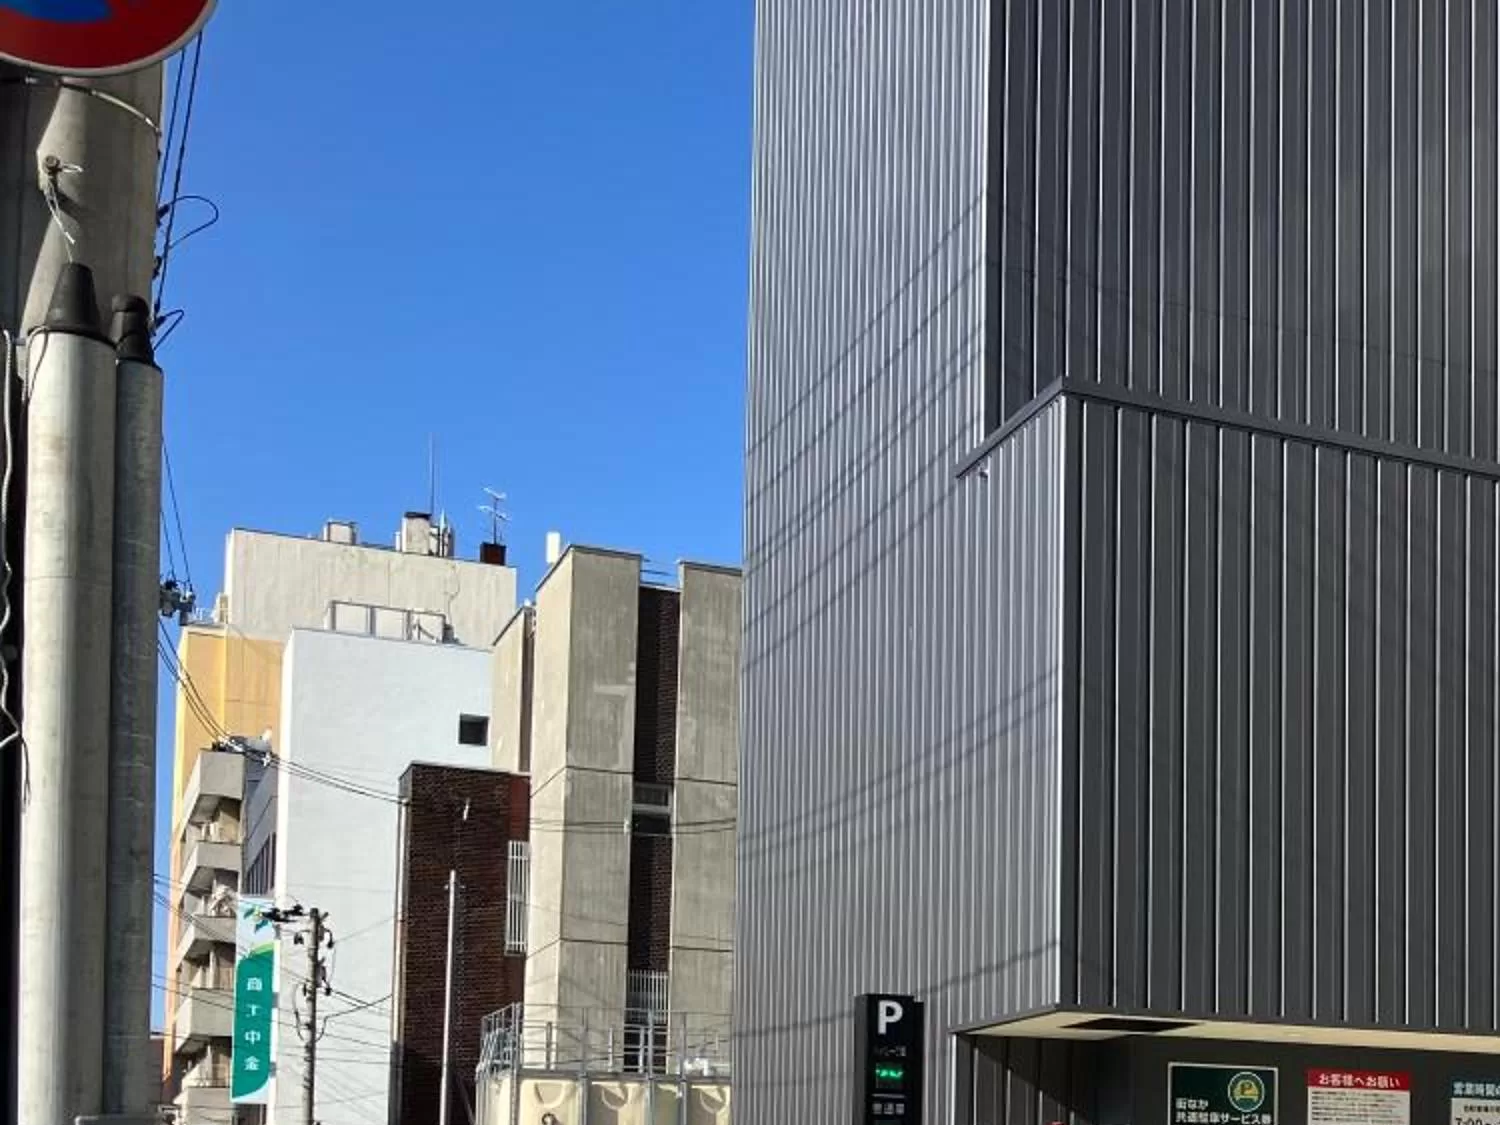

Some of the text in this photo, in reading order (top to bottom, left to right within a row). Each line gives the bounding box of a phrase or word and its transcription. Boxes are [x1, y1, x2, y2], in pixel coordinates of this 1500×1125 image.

[244, 977, 262, 1071] 商工中金
[877, 999, 904, 1035] P
[1319, 1073, 1401, 1088] お客様へお願い
